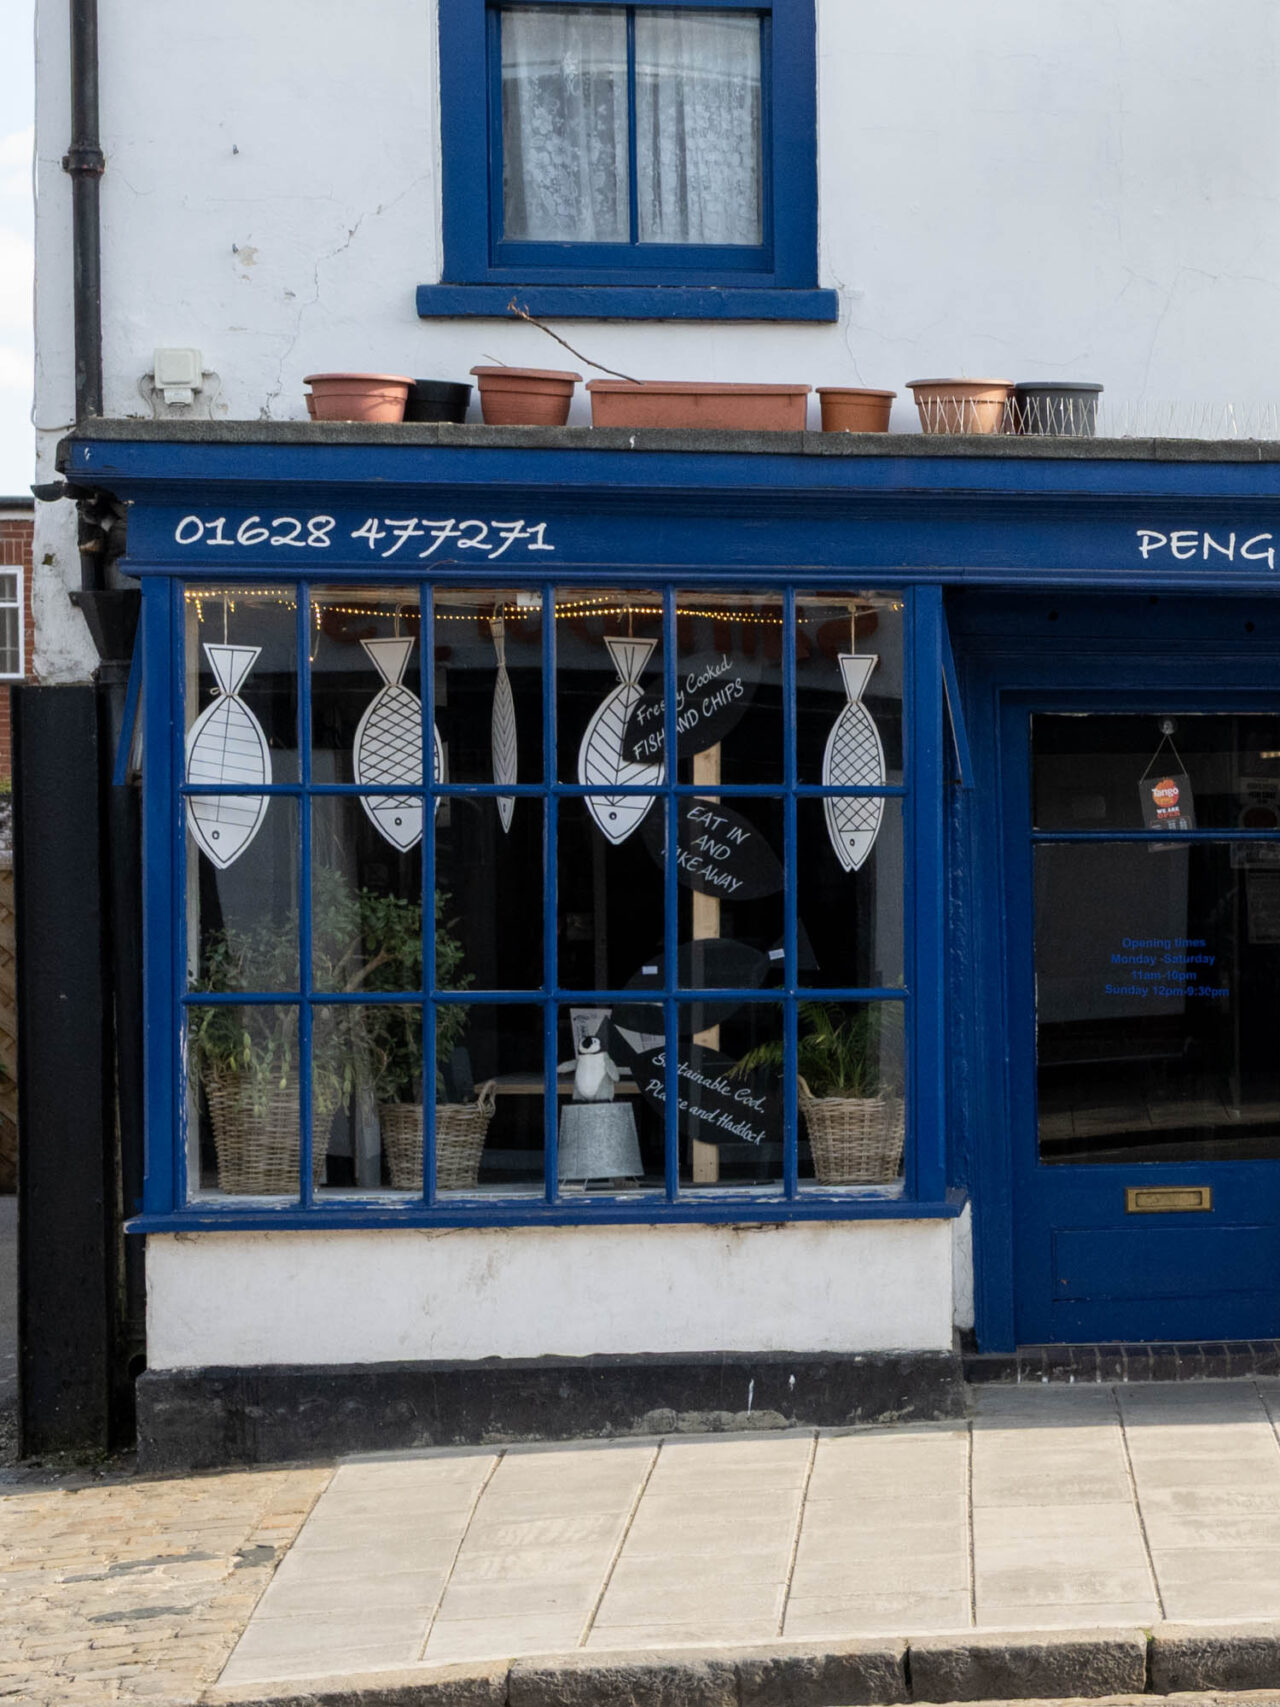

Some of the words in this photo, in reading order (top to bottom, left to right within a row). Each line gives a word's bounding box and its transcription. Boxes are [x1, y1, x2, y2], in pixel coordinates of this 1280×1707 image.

[174, 515, 336, 547] 01628
[351, 517, 555, 559] 477271
[686, 653, 733, 694] Cooked
[633, 729, 665, 761] FISH
[702, 677, 744, 718] CHIPS
[1151, 787, 1179, 797] Tango
[686, 806, 728, 831] EAT
[726, 826, 751, 845] IN
[690, 834, 731, 860] AND
[697, 864, 743, 893] AWAY
[1110, 954, 1156, 966] Monday
[1122, 937, 1171, 949] Opening
[1174, 937, 1206, 948] times
[1105, 984, 1149, 997] Sunday
[652, 1052, 731, 1096] Stainable
[689, 1104, 720, 1122] and
[716, 1111, 767, 1147] Haddock
